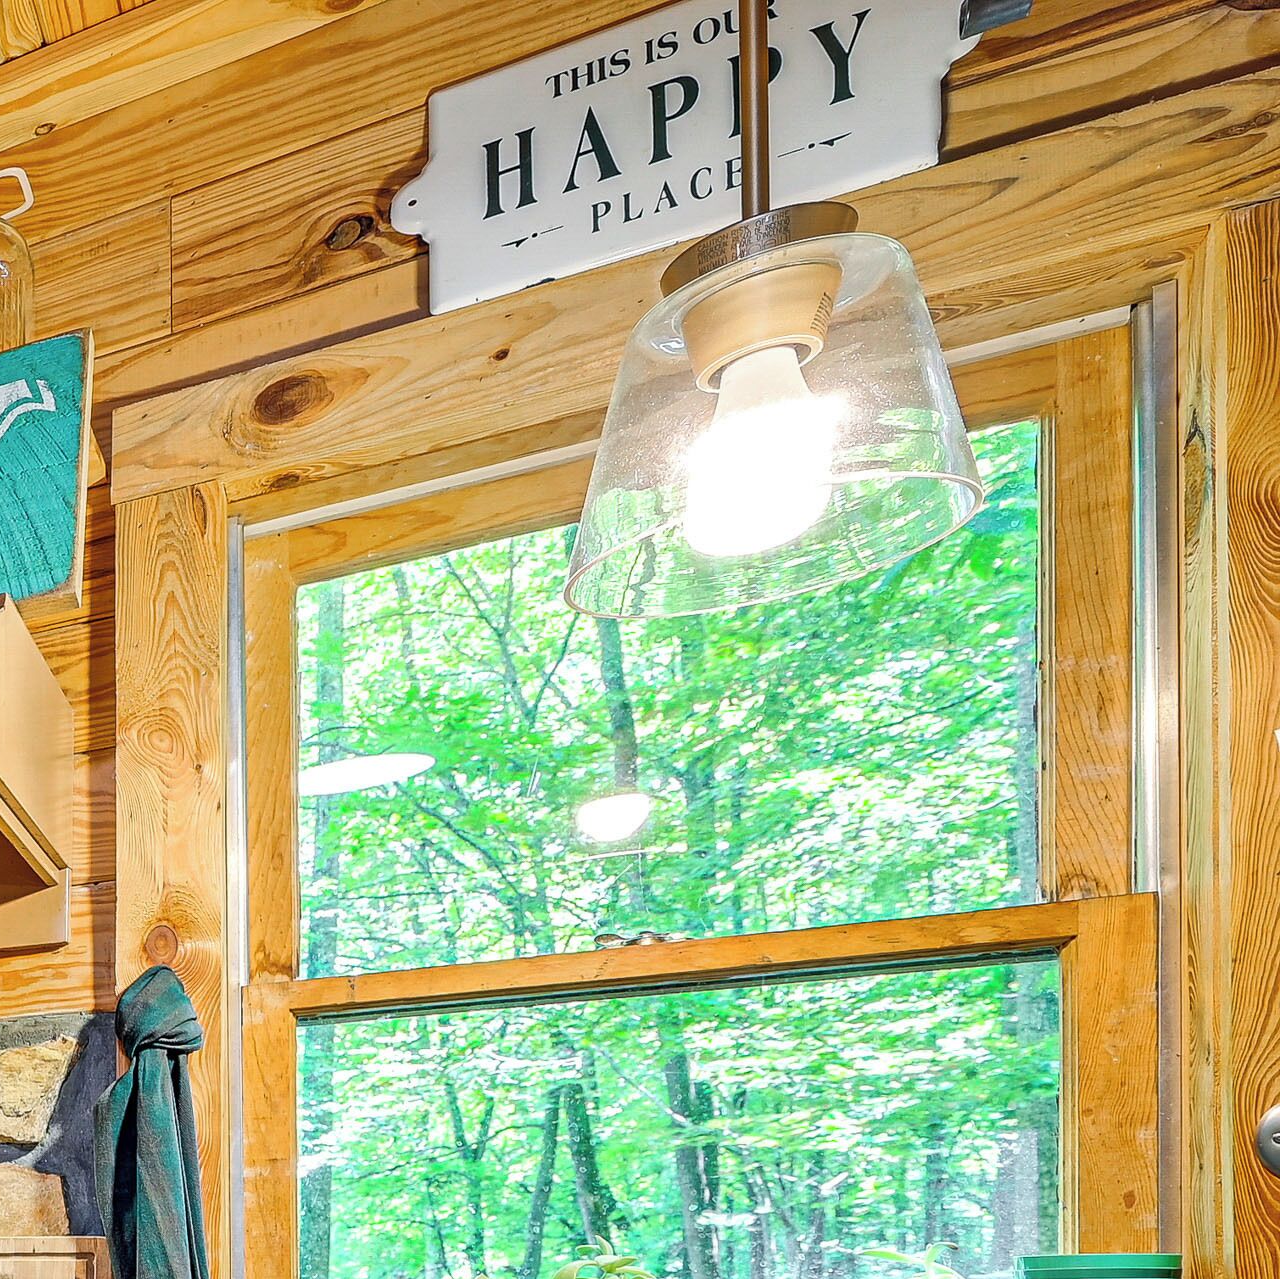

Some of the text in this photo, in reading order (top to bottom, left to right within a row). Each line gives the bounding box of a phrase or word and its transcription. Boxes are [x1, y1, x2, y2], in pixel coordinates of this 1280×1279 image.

[545, 49, 630, 100] THIS
[644, 31, 679, 65] IS
[591, 156, 743, 233] PLACE
